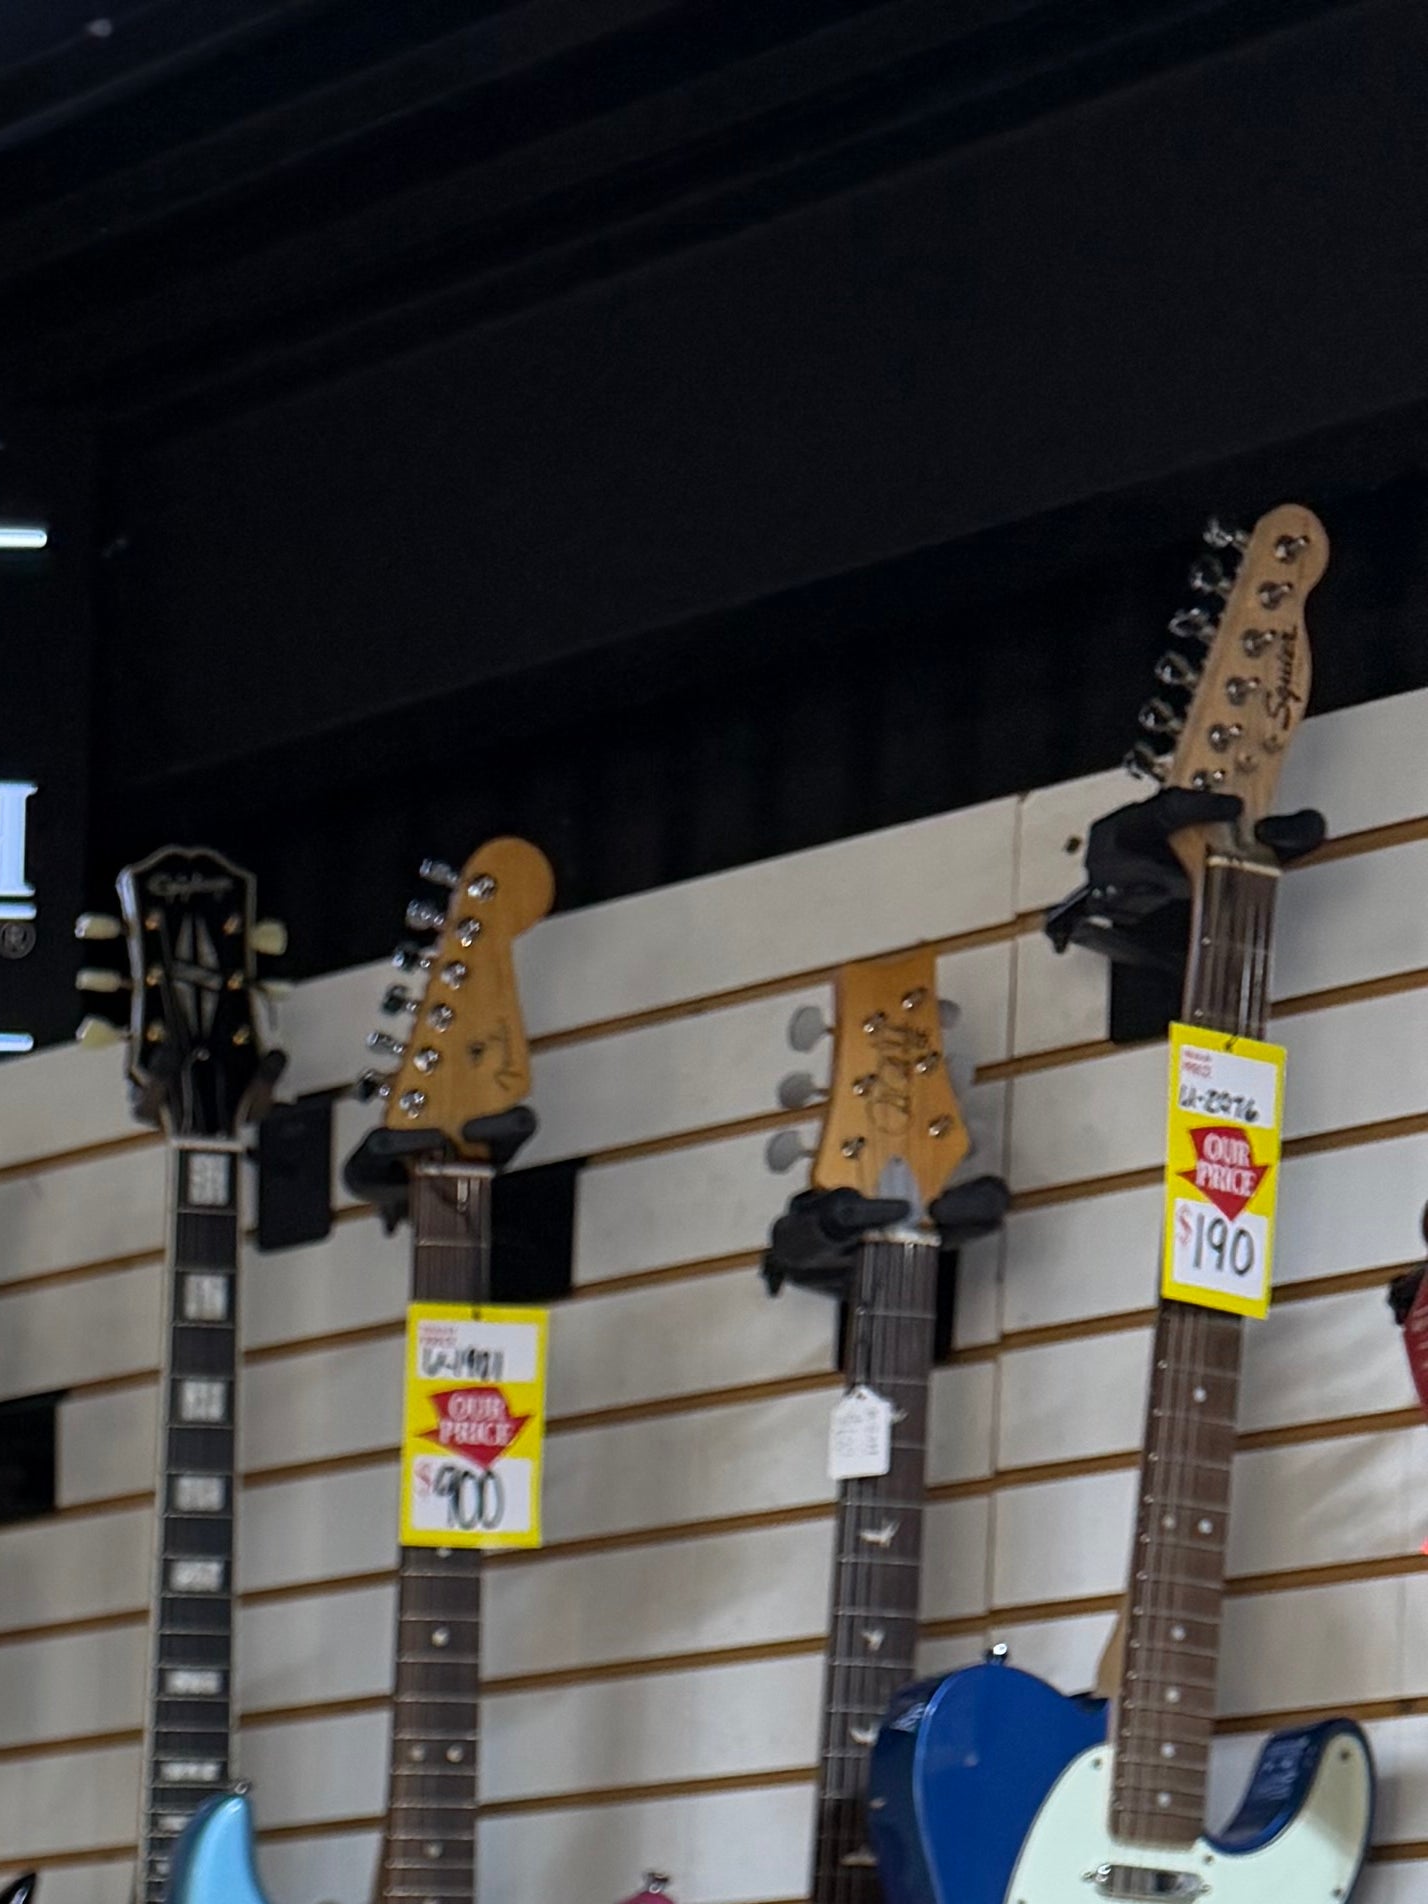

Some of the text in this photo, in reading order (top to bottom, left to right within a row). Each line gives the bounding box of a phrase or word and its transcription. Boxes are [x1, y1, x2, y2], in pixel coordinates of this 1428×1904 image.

[1202, 1132, 1252, 1168] OUR
[1195, 1158, 1258, 1198] PRICE
[1176, 1203, 1255, 1276] $190
[447, 1392, 507, 1422] OUR
[438, 1419, 514, 1447] PRICE
